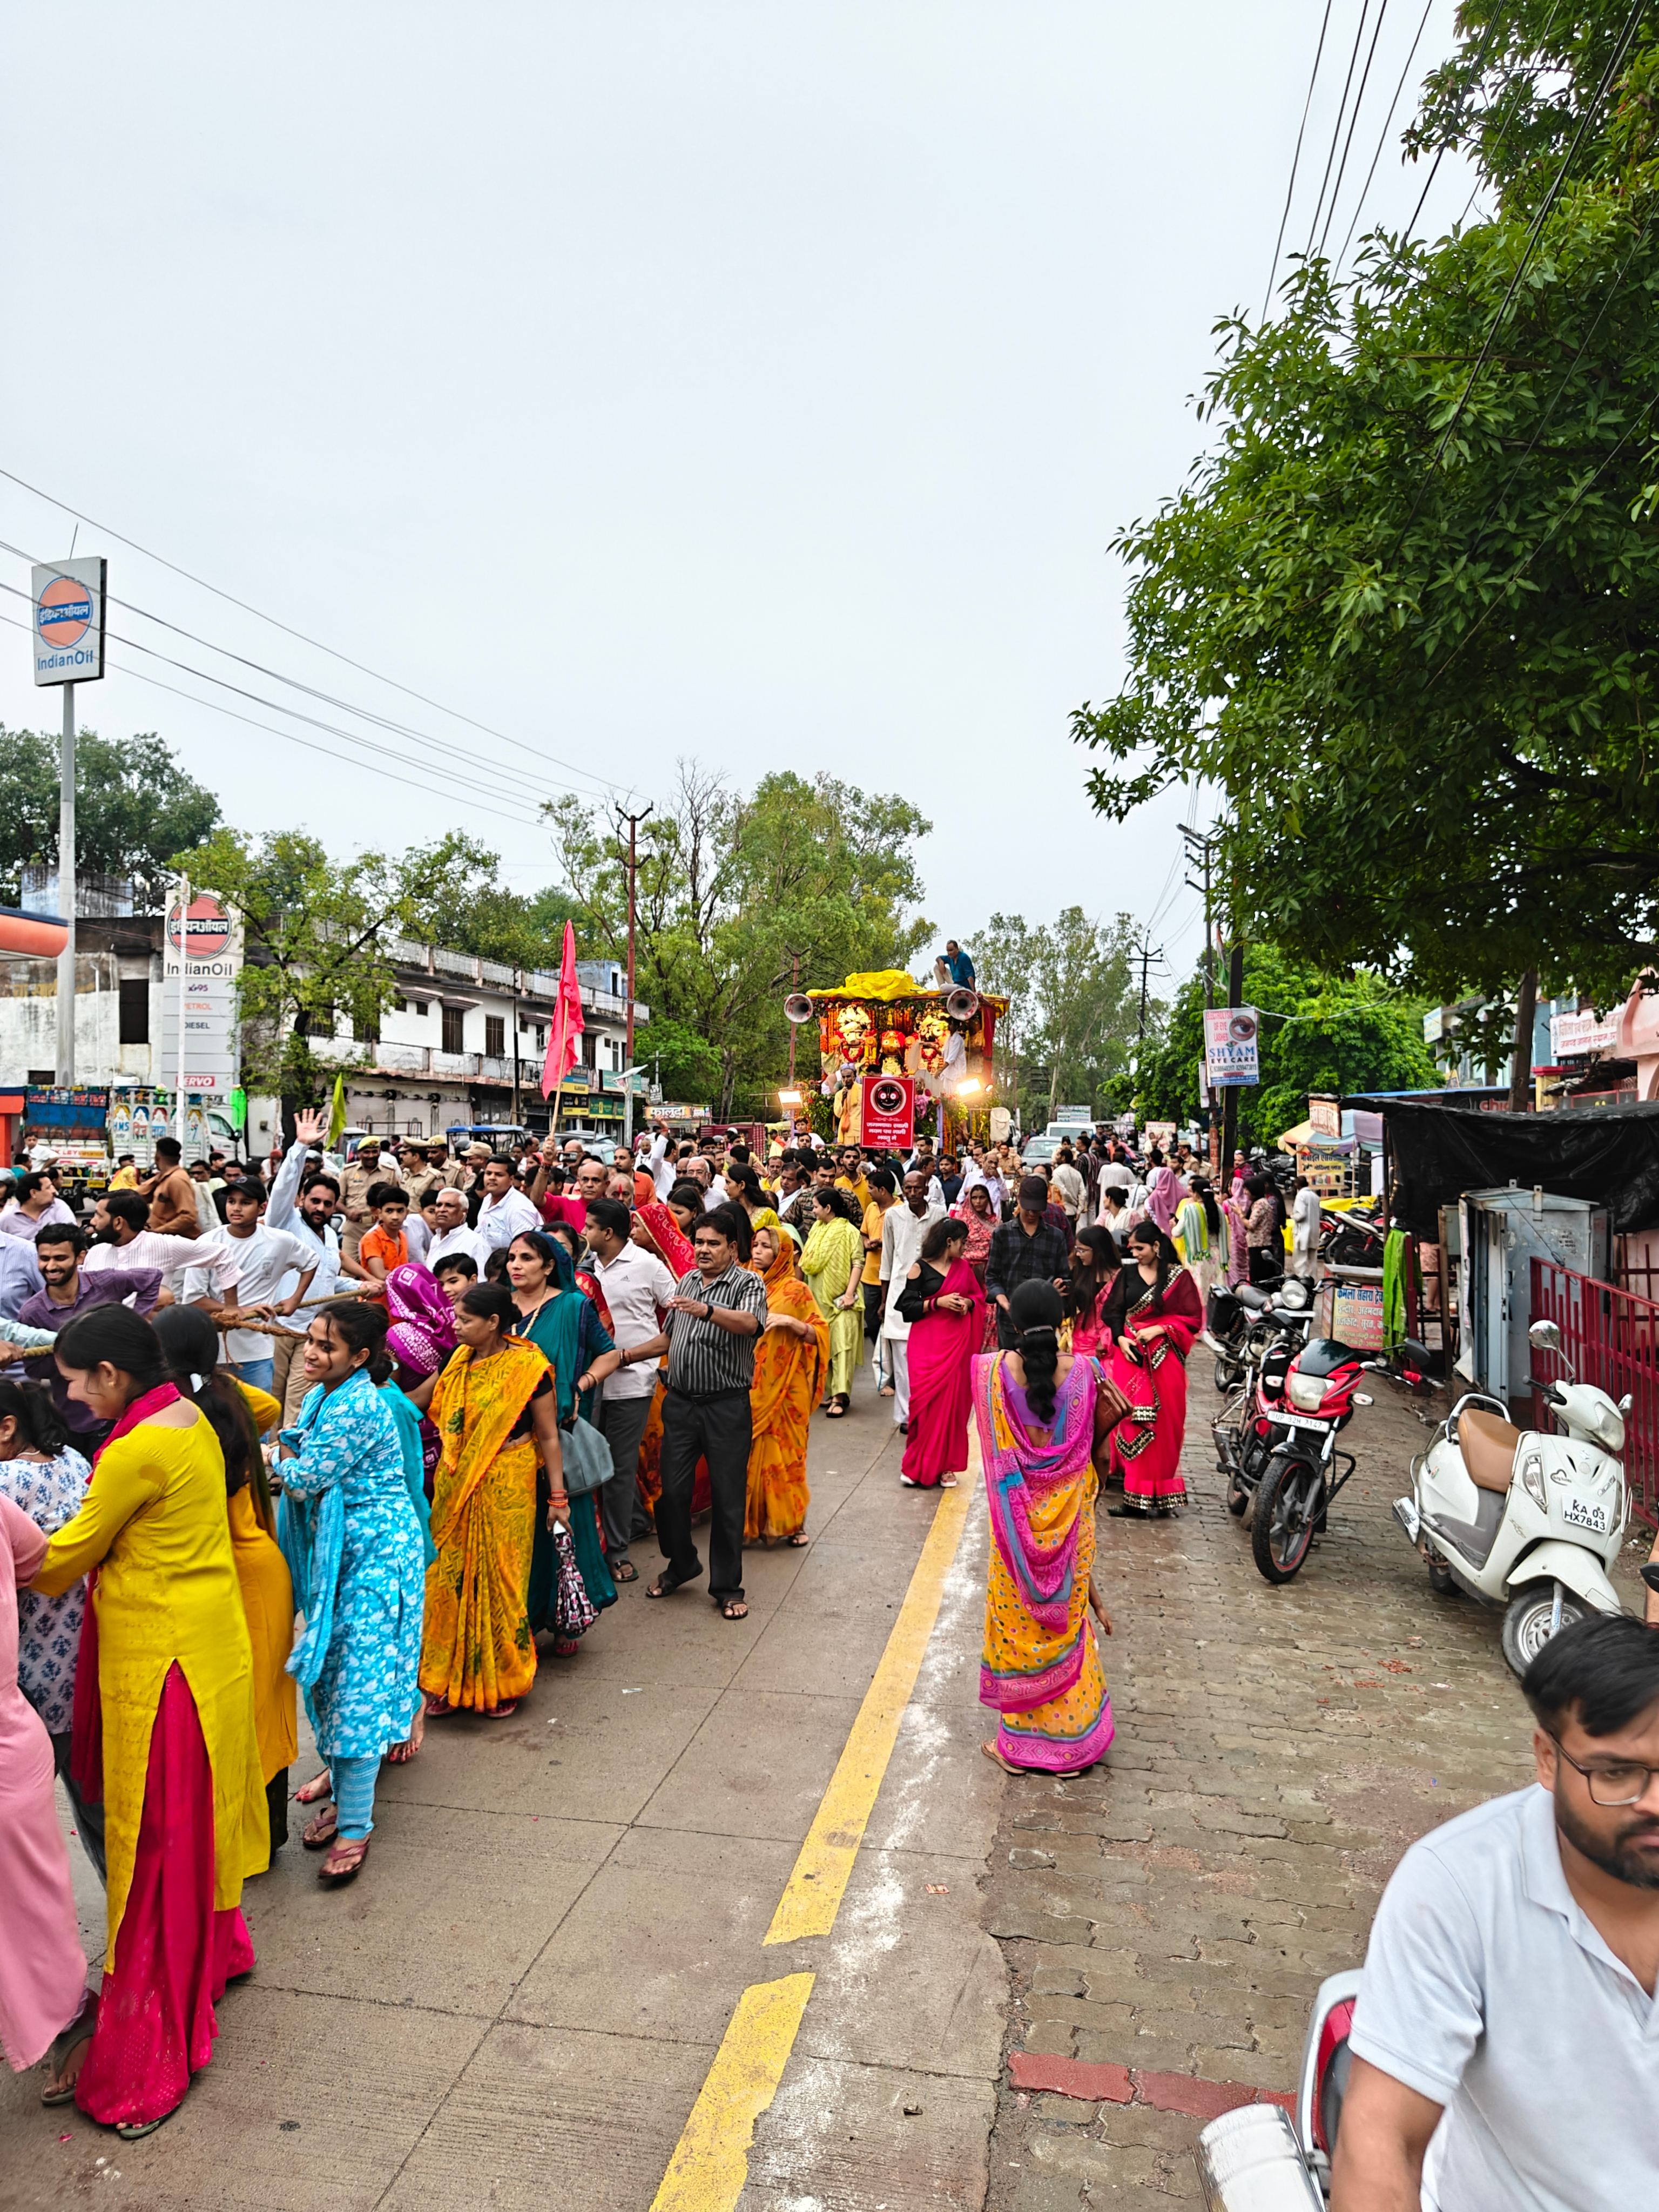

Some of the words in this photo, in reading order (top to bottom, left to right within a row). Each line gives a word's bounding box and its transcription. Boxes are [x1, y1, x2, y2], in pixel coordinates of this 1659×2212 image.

[38, 650, 93, 671] IndianOil
[170, 919, 228, 935] इंयनऑयल
[1210, 1047, 1255, 1057] SHYAM
[178, 1077, 212, 1085] ERVO
[1337, 1288, 1355, 1300] कमला
[1357, 1290, 1374, 1301] सहारा
[1358, 1306, 1383, 1316] अहमदाब
[1572, 1502, 1588, 1515] KA
[1592, 1509, 1604, 1521] 03
[1564, 1510, 1605, 1530] HX7843
